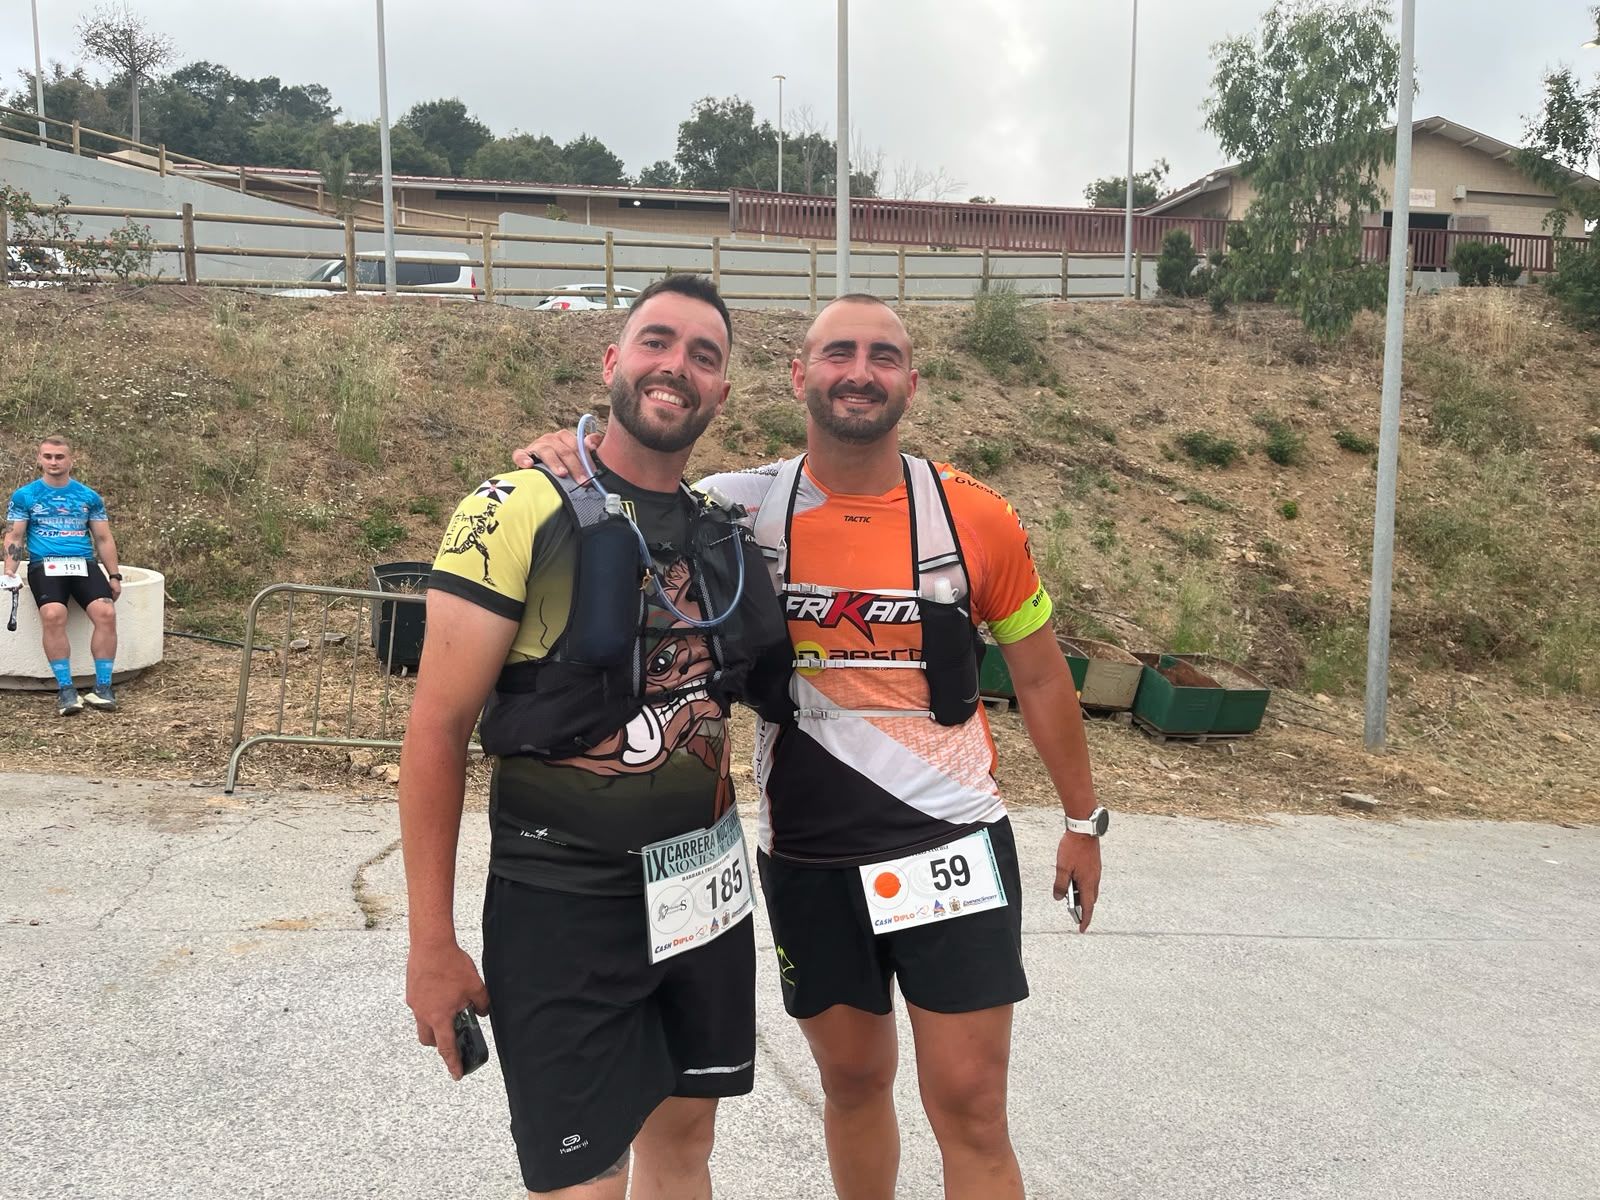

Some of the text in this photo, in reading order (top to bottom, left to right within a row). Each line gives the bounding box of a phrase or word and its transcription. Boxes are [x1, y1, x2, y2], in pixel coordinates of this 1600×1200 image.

[844, 515, 871, 523] TACTIC
[64, 563, 81, 571] 191
[646, 847, 668, 883] IX
[667, 834, 715, 863] CARRERA
[668, 850, 716, 876] MONTES
[706, 857, 743, 910] 185
[930, 854, 971, 891] 59
[893, 912, 915, 922] DIPLO
[655, 934, 694, 954] CASH DIPLO
